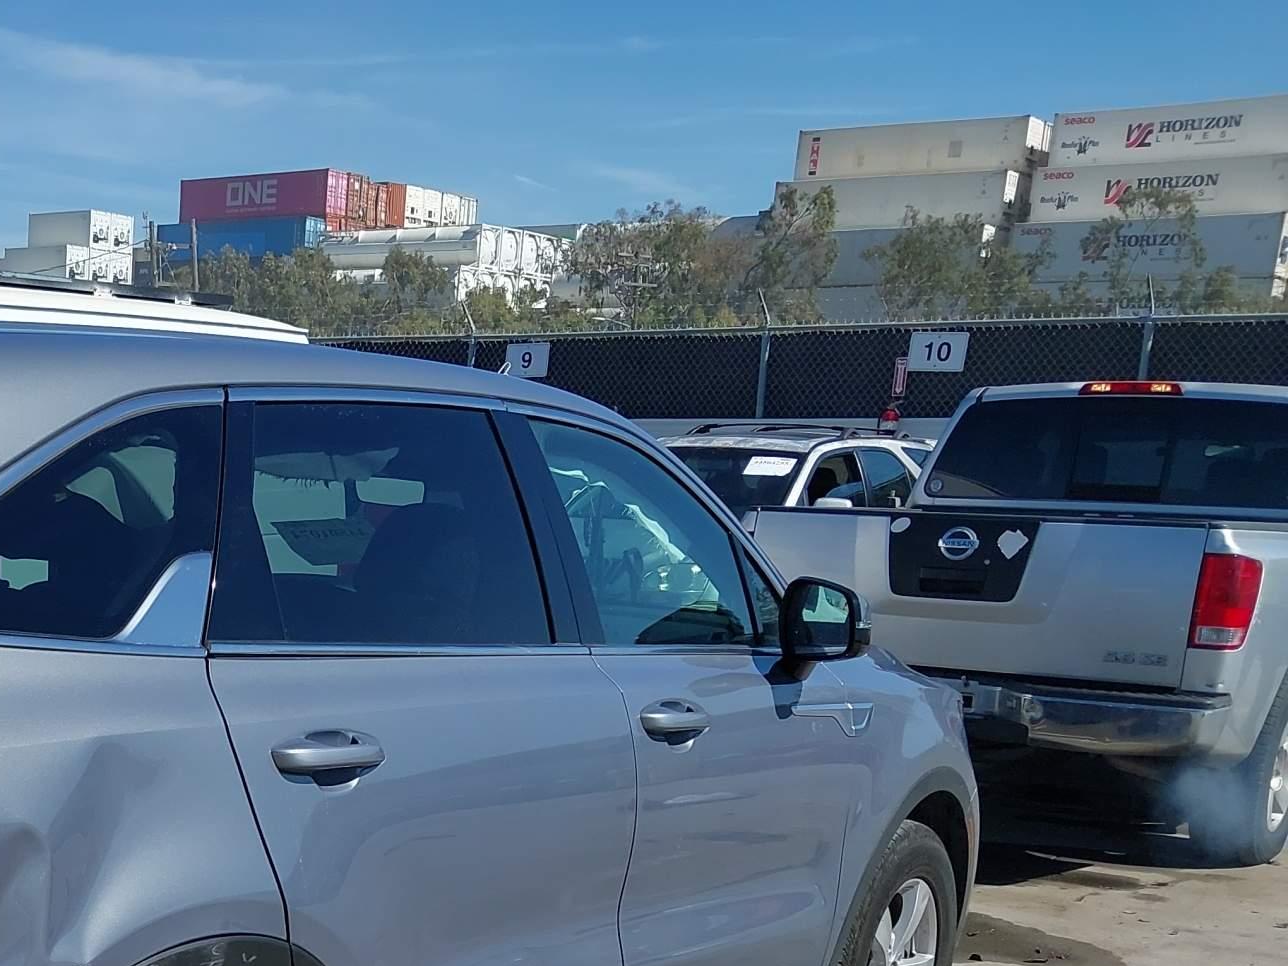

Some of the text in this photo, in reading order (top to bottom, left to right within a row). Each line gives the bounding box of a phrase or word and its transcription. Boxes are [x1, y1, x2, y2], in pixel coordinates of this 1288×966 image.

[1064, 116, 1096, 126] seaco
[1158, 114, 1244, 134] HORIZON
[1155, 130, 1227, 143] LINES
[1043, 171, 1074, 181] seaco
[1136, 173, 1220, 190] HORIZON
[226, 179, 278, 207] ONE
[521, 351, 533, 369] 9
[924, 341, 952, 362] 10
